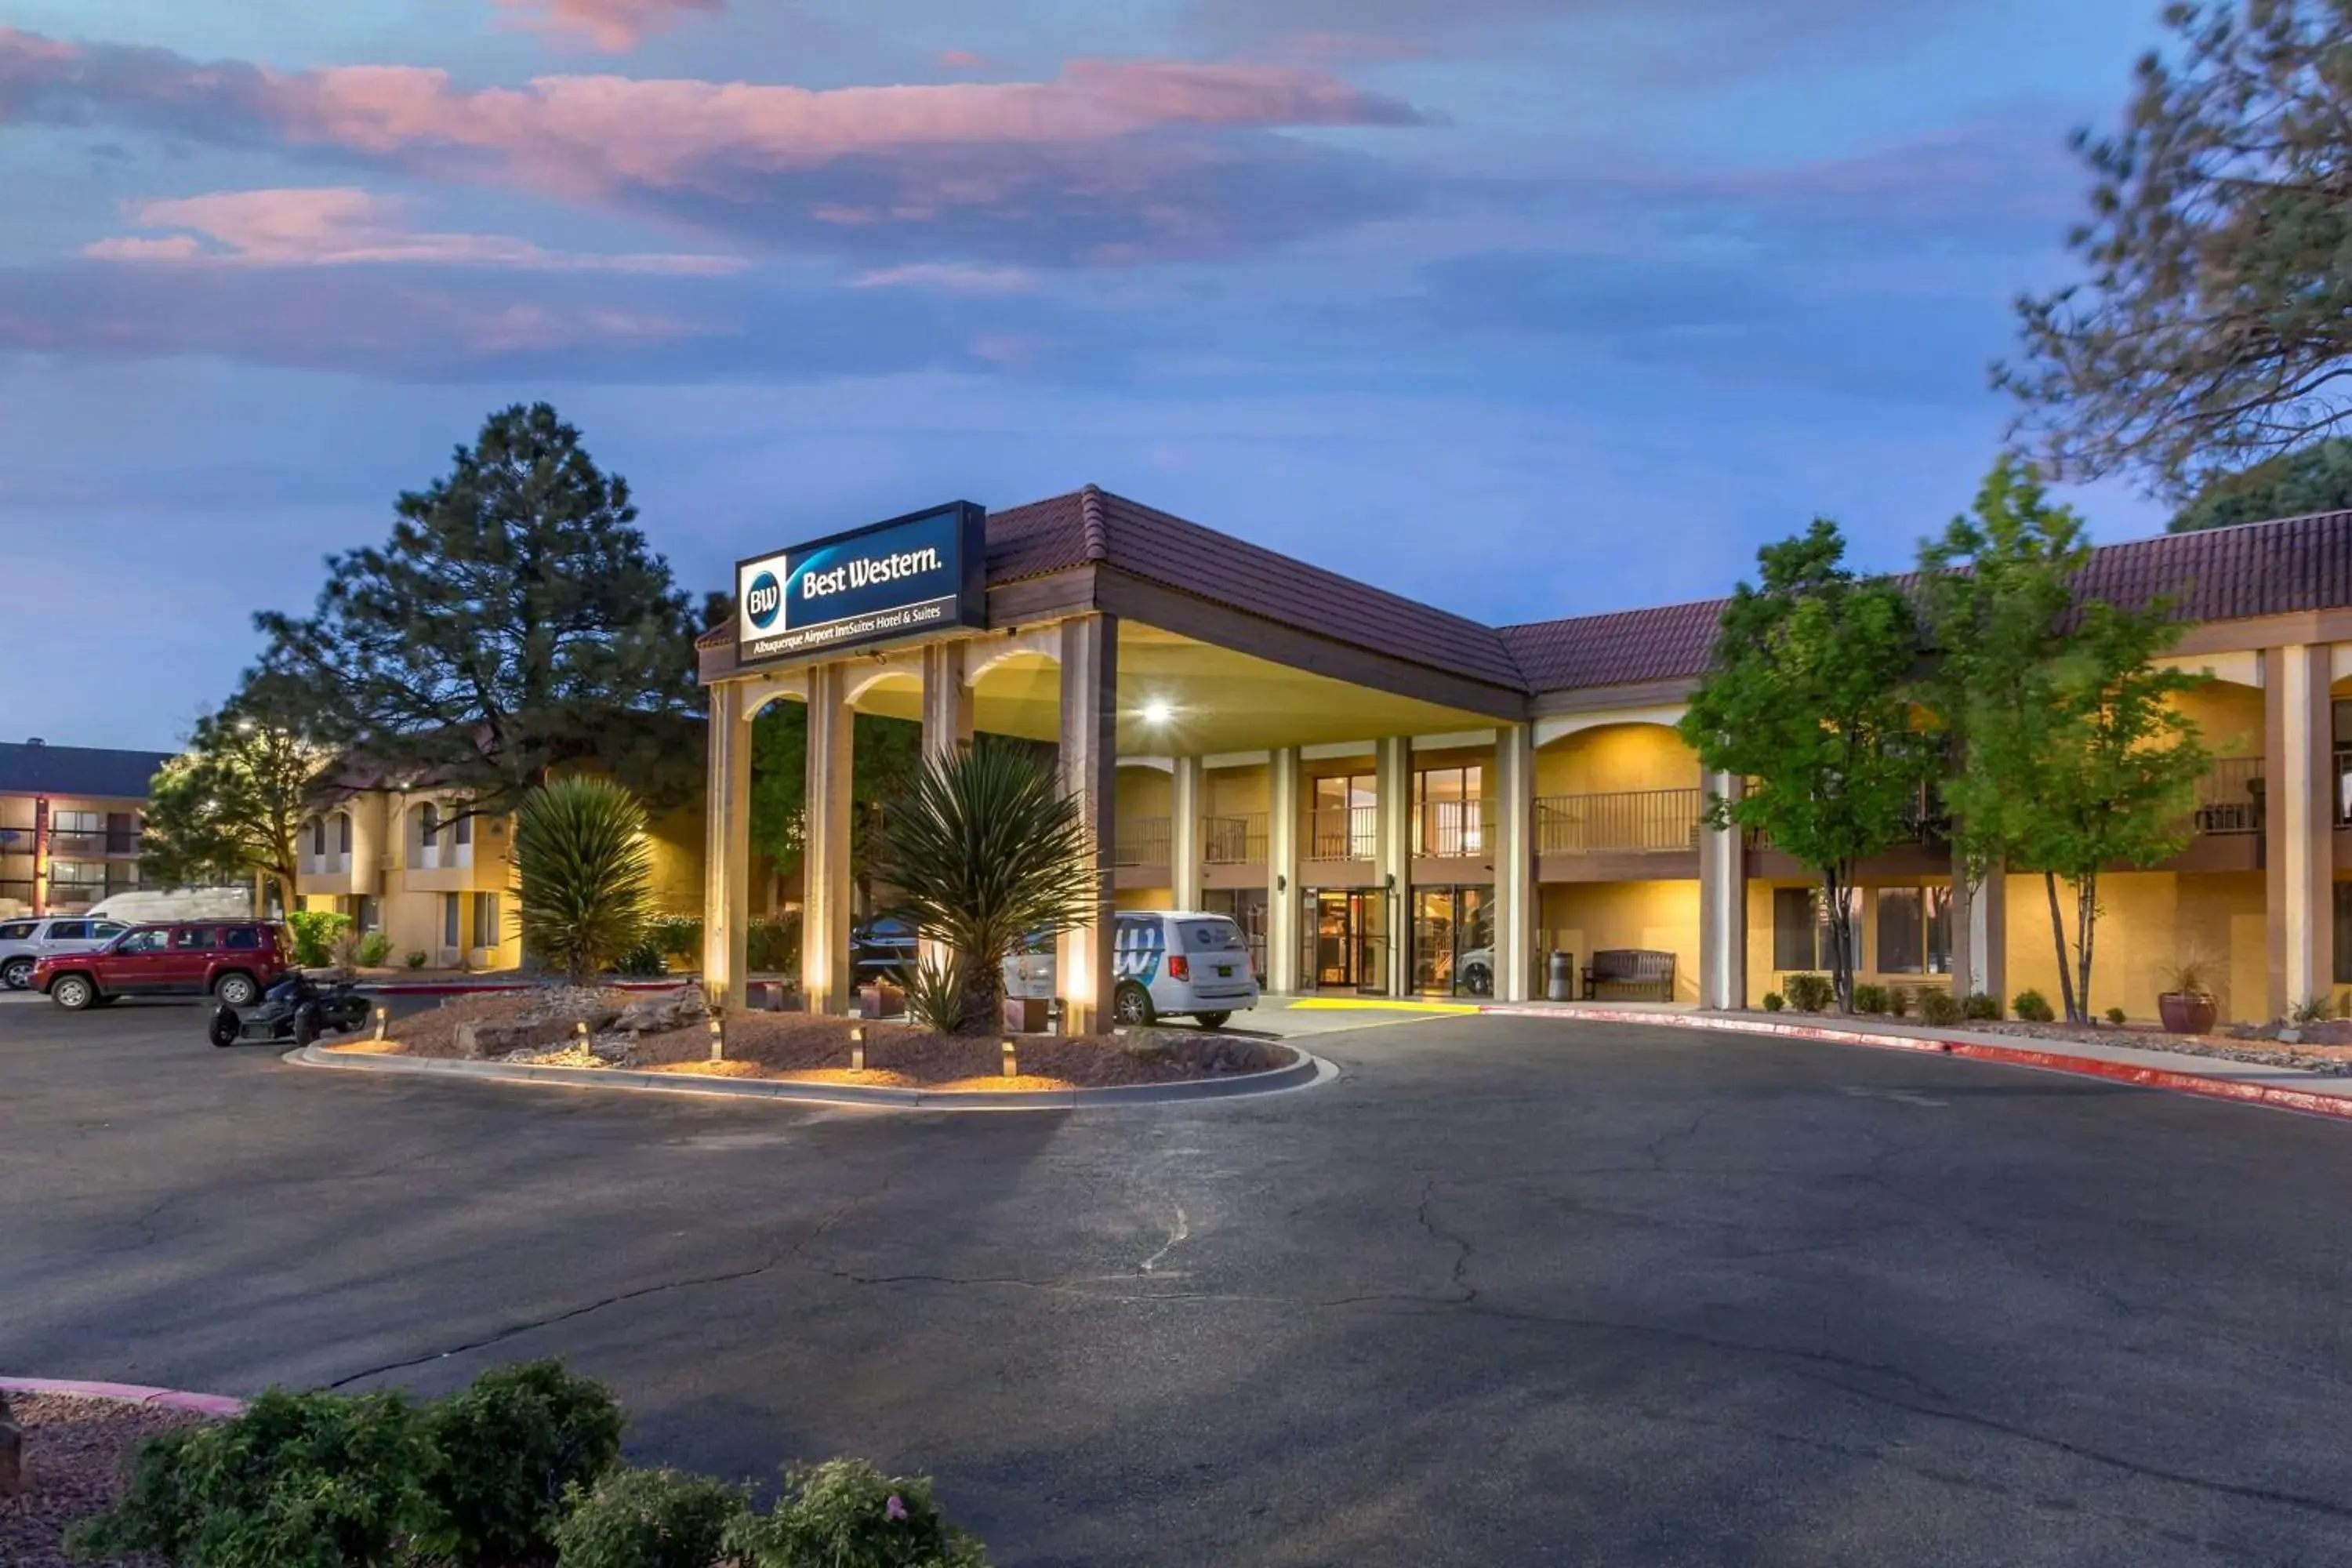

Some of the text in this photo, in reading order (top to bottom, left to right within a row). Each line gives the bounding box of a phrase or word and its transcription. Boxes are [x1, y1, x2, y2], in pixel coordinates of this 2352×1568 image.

[750, 586, 778, 614] BW
[803, 567, 847, 600] Best
[753, 606, 941, 655] Albuquerque Airport InnSuites Hotel & Suites
